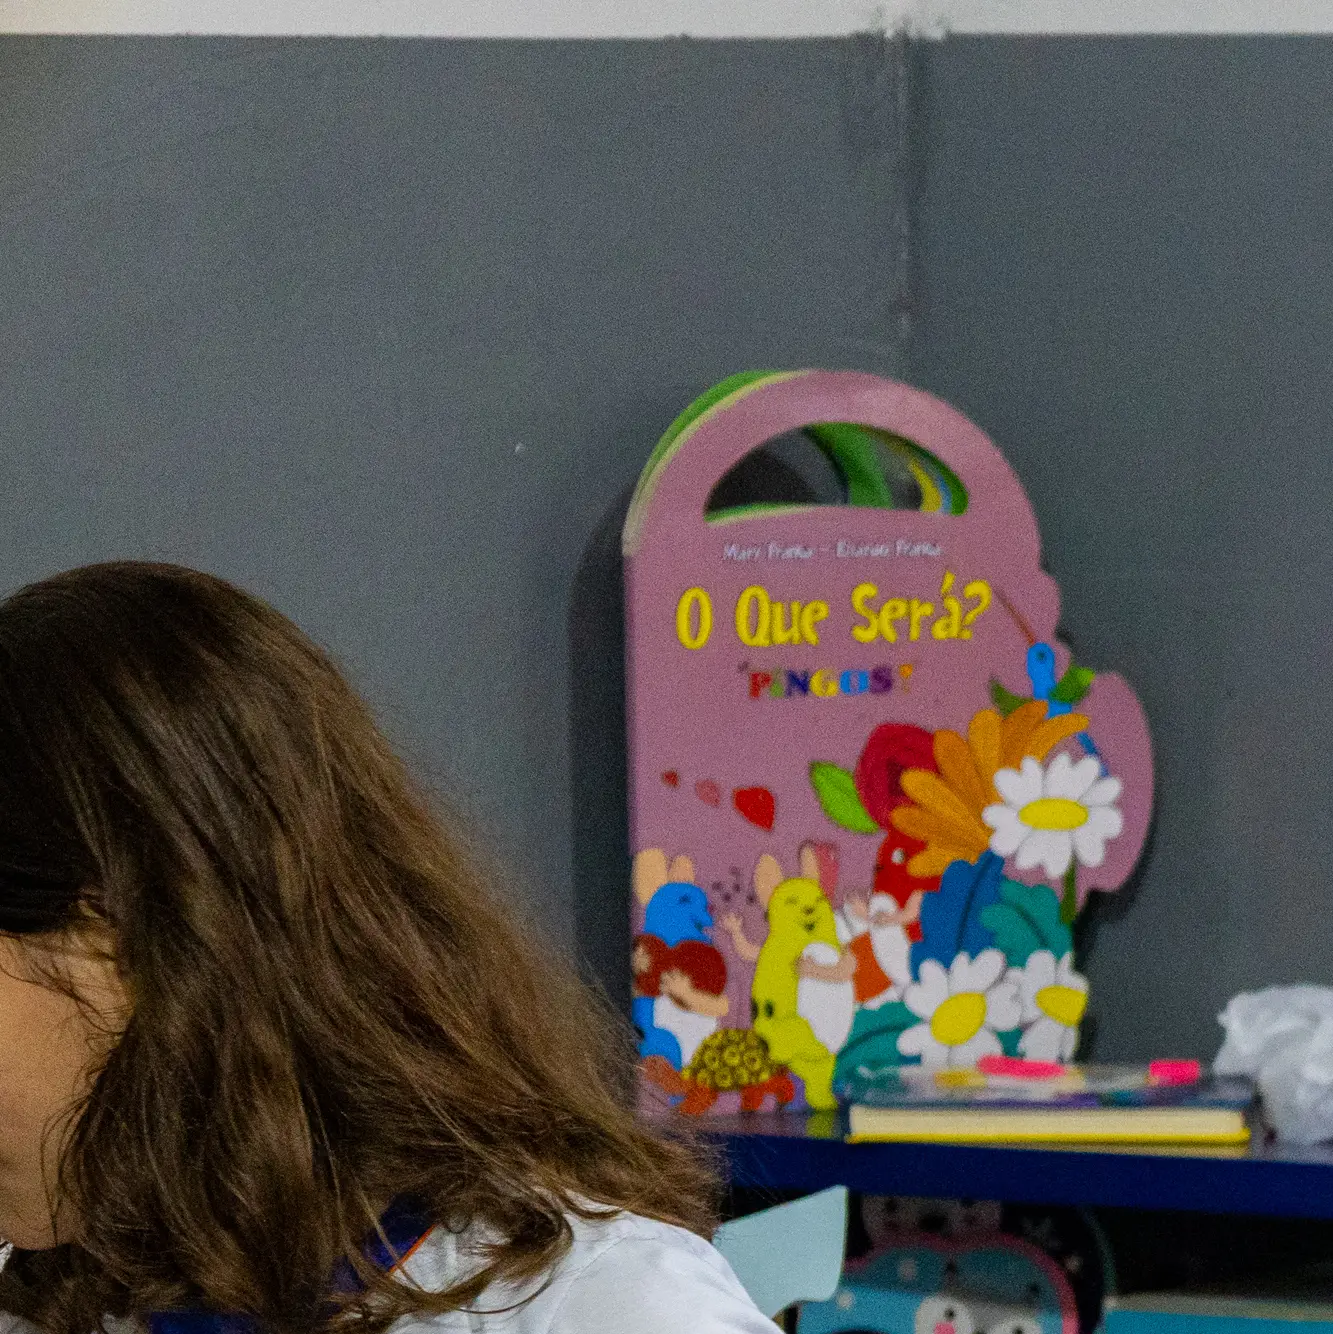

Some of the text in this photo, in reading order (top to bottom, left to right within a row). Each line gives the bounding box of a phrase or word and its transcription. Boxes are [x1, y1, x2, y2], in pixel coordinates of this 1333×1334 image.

[676, 571, 993, 650] O Que Será?
